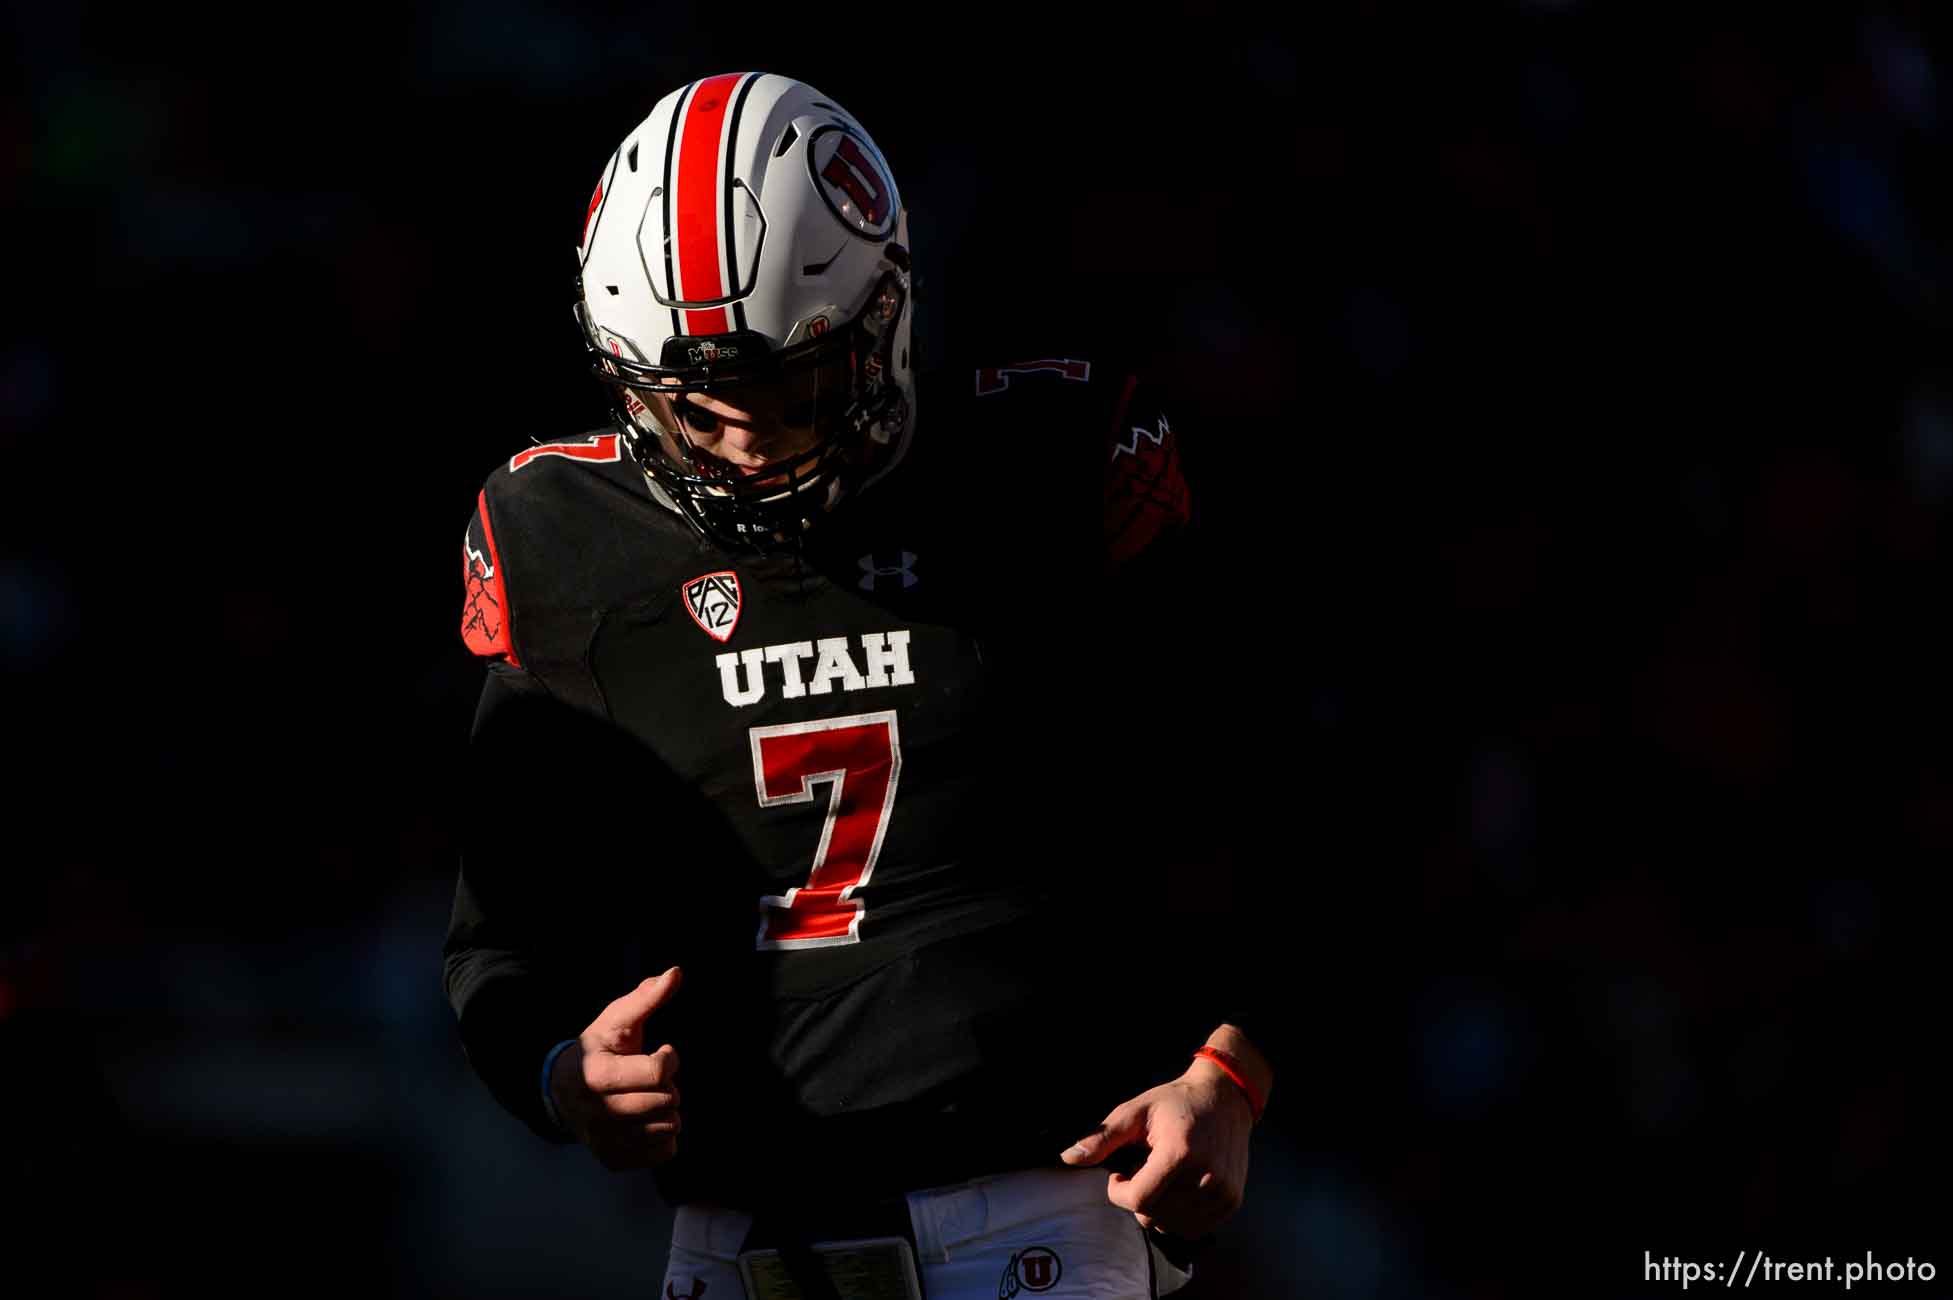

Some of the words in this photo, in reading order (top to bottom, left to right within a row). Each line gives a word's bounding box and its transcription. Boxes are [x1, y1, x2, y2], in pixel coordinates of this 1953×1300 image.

[821, 135, 889, 226] U
[510, 433, 621, 473] 7
[687, 576, 738, 620] PAC
[704, 602, 733, 629] 12
[716, 630, 915, 707] UTAH
[749, 709, 903, 951] 7
